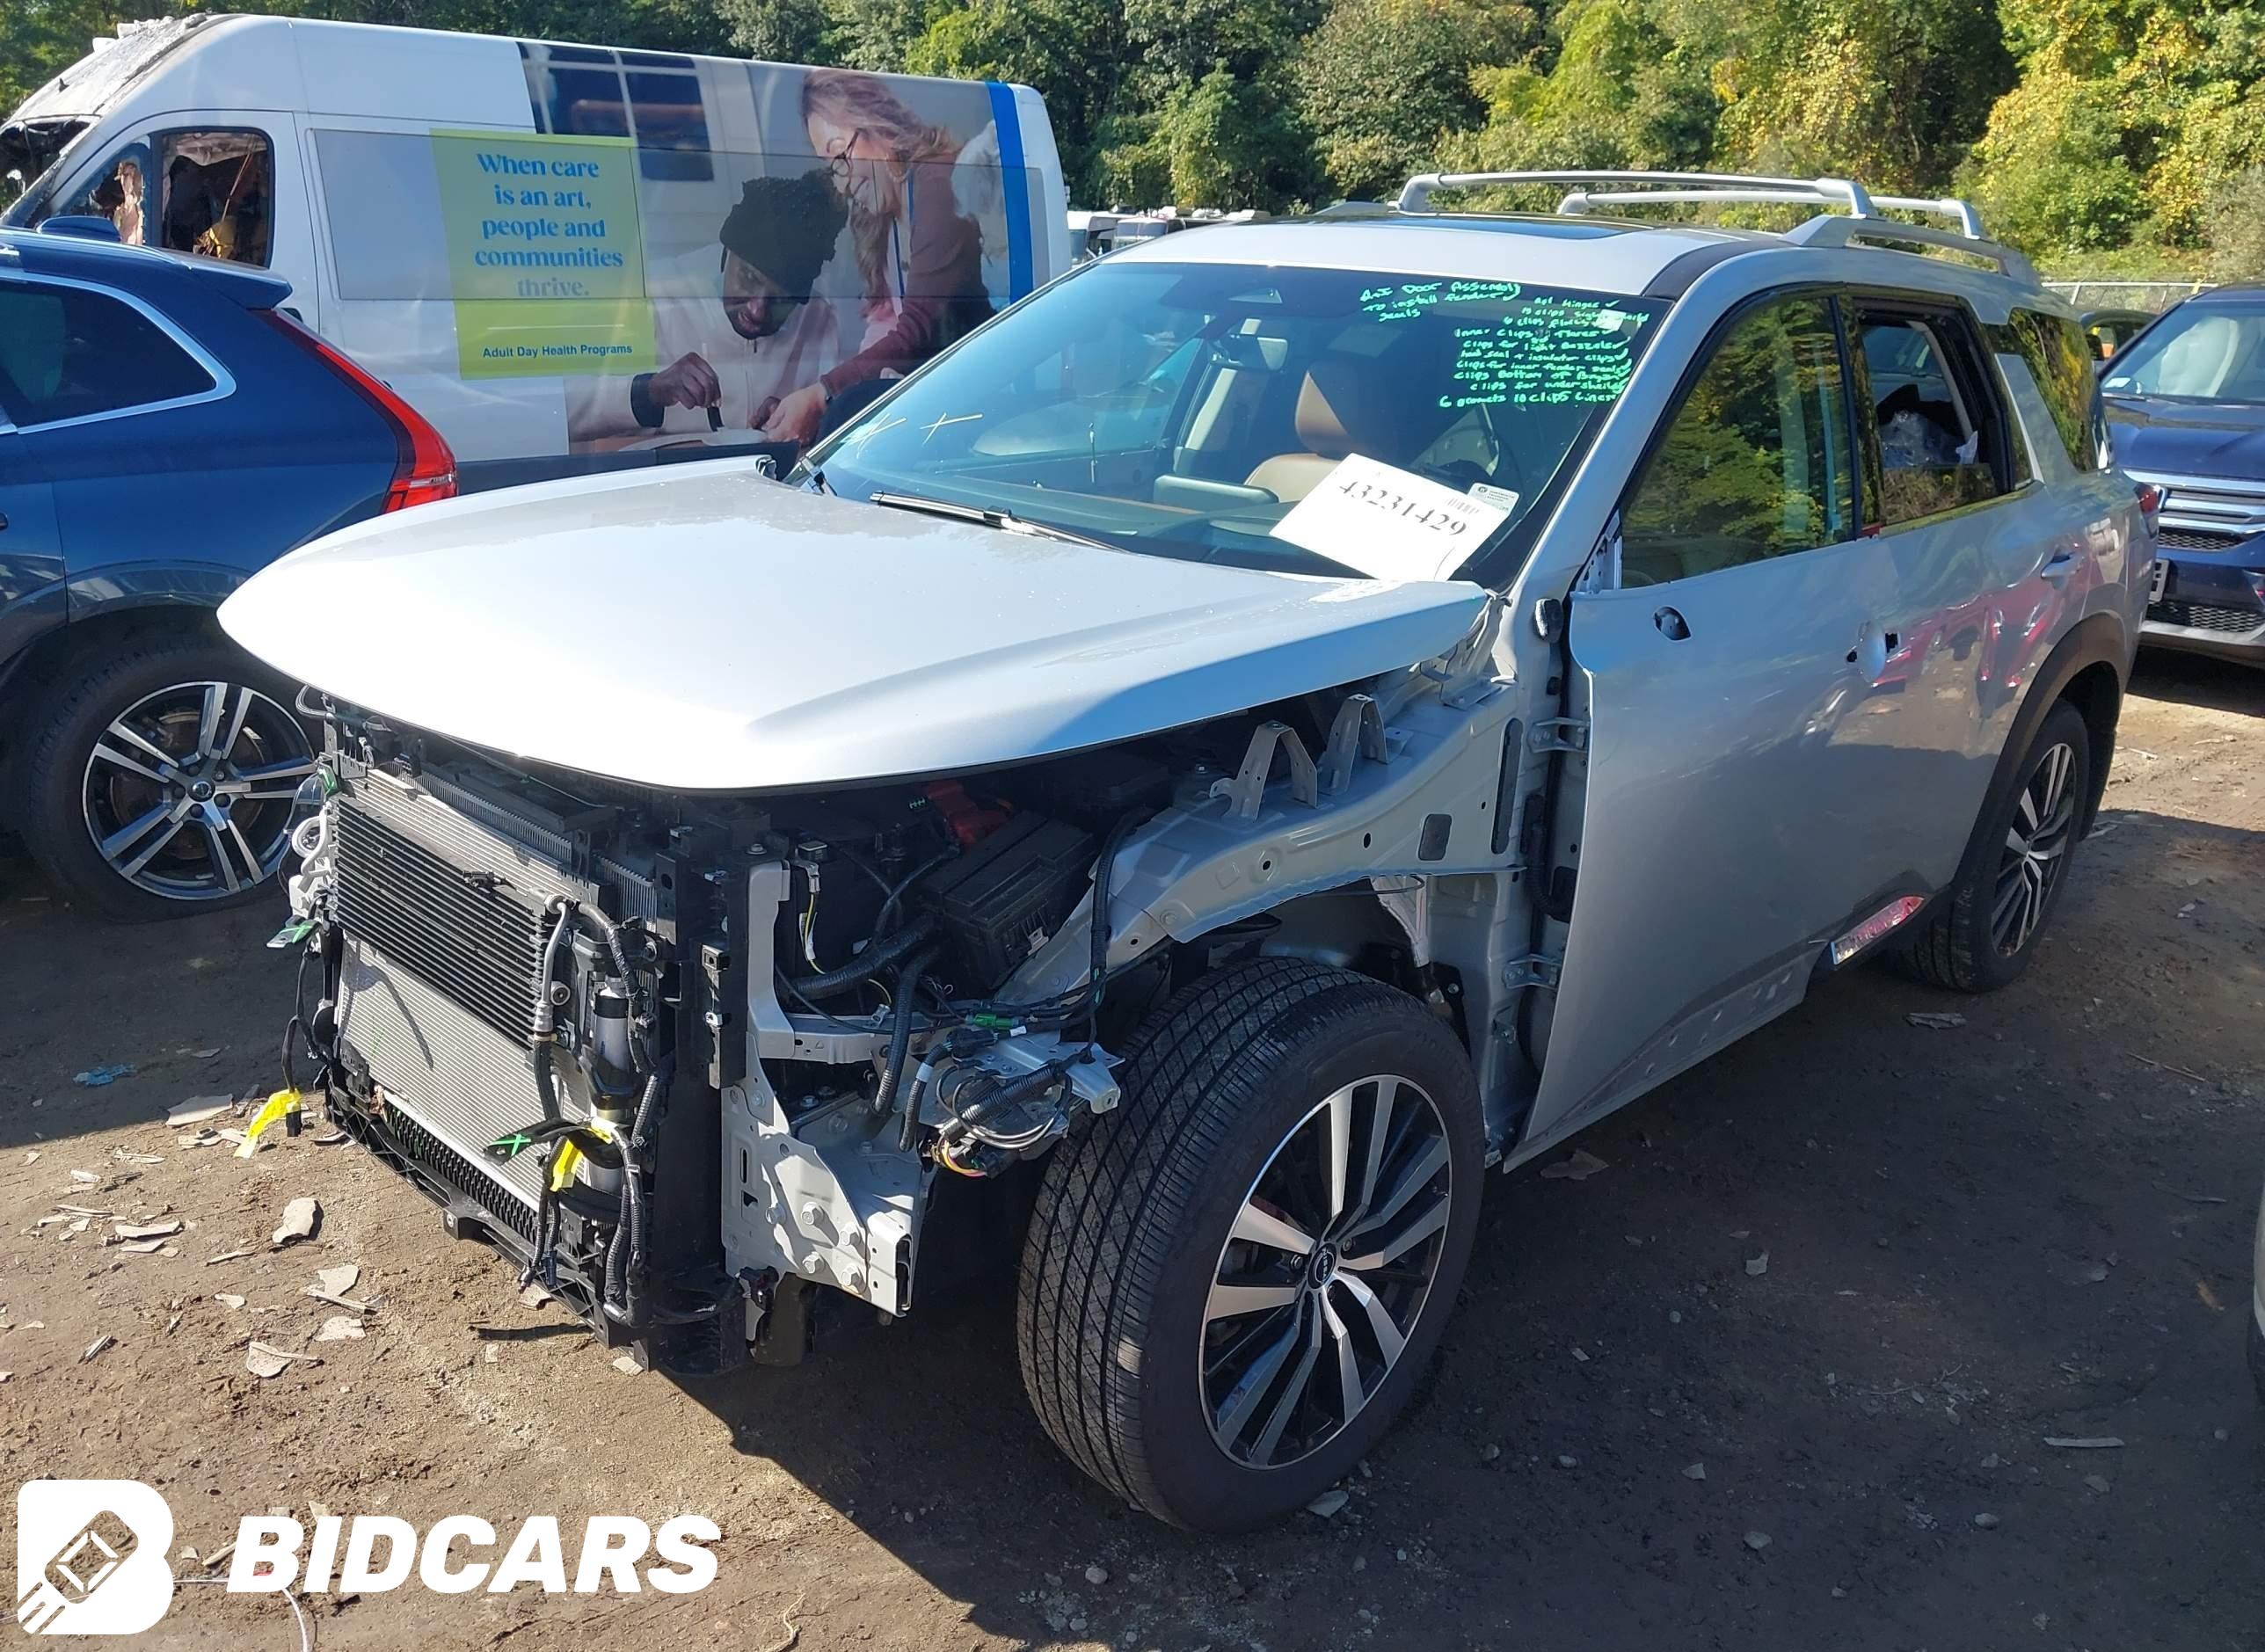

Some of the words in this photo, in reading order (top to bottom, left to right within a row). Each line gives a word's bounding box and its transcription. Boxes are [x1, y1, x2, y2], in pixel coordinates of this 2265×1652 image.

[477, 154, 546, 176] When
[551, 162, 599, 178] care
[494, 185, 514, 205] is
[520, 190, 549, 206] an
[554, 190, 592, 208] art,
[482, 218, 559, 240] people
[564, 220, 606, 237] and
[475, 247, 623, 267] communities
[517, 278, 590, 297] thrive.
[483, 347, 513, 359] Adult
[517, 346, 538, 359] Day
[542, 346, 577, 357] Health
[580, 344, 633, 357] Programs
[1339, 480, 1468, 536] 43231429
